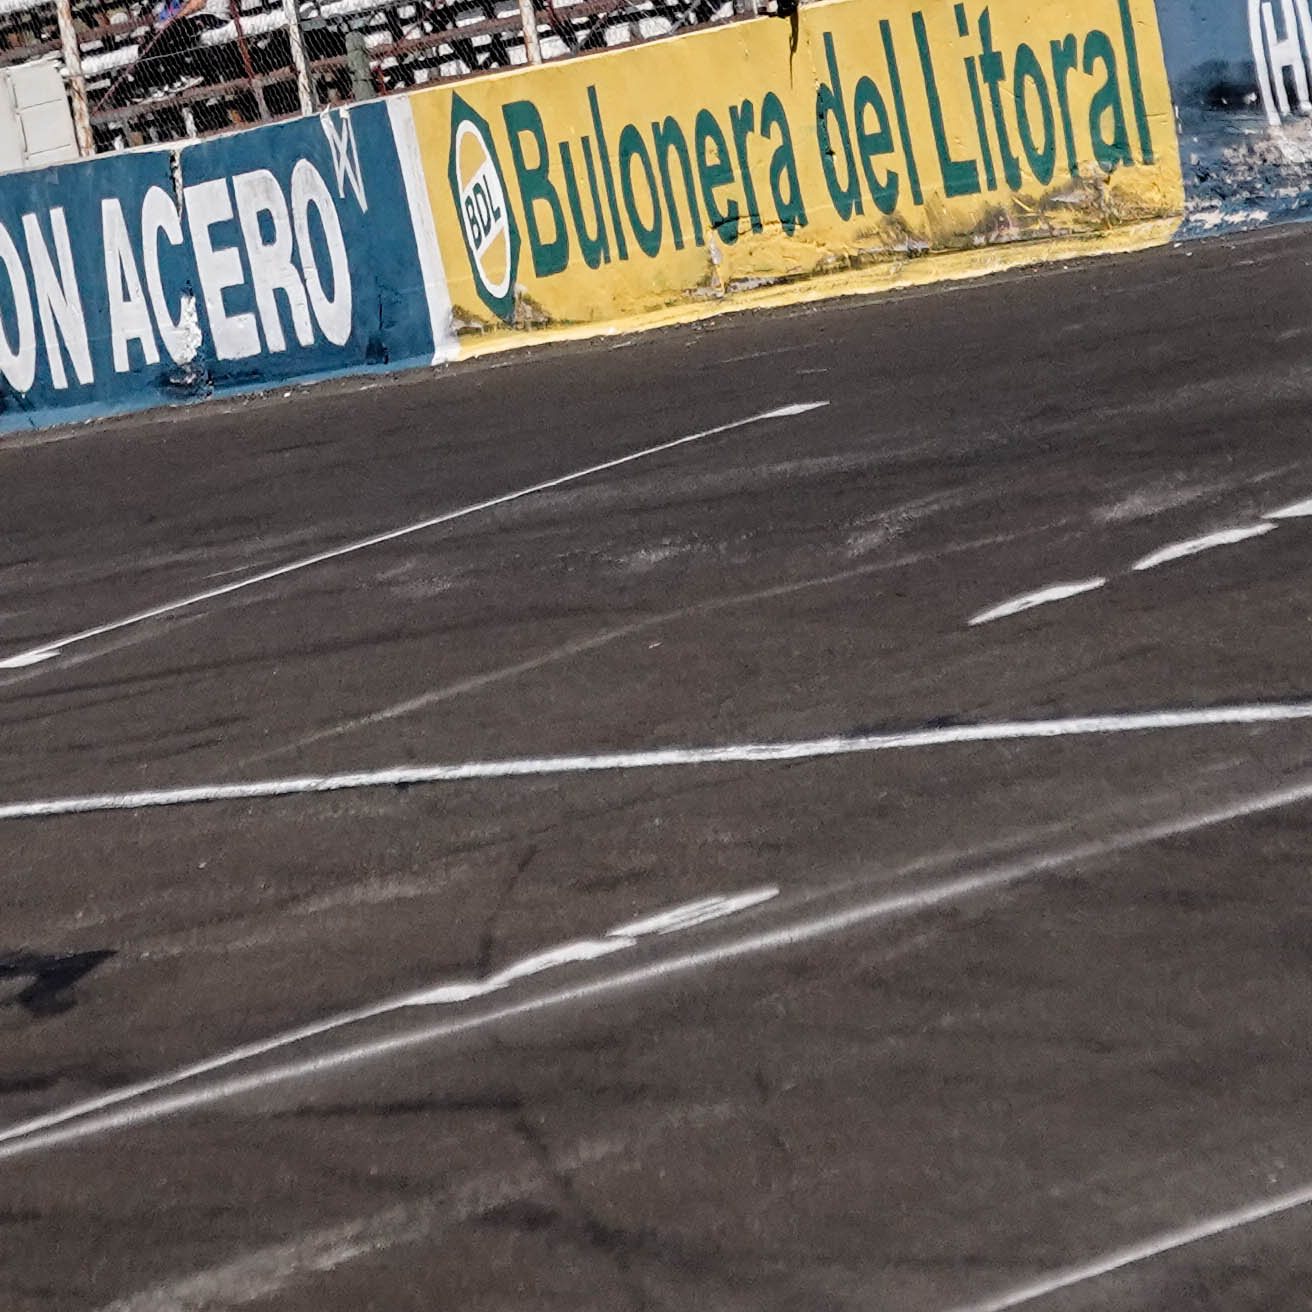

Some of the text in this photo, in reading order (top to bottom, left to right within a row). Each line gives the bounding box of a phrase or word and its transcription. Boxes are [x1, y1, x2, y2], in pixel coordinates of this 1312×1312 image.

[465, 174, 501, 251] BDL
[502, 85, 807, 278] Bulonera
[816, 19, 924, 221] del
[101, 158, 352, 373] ACERO
